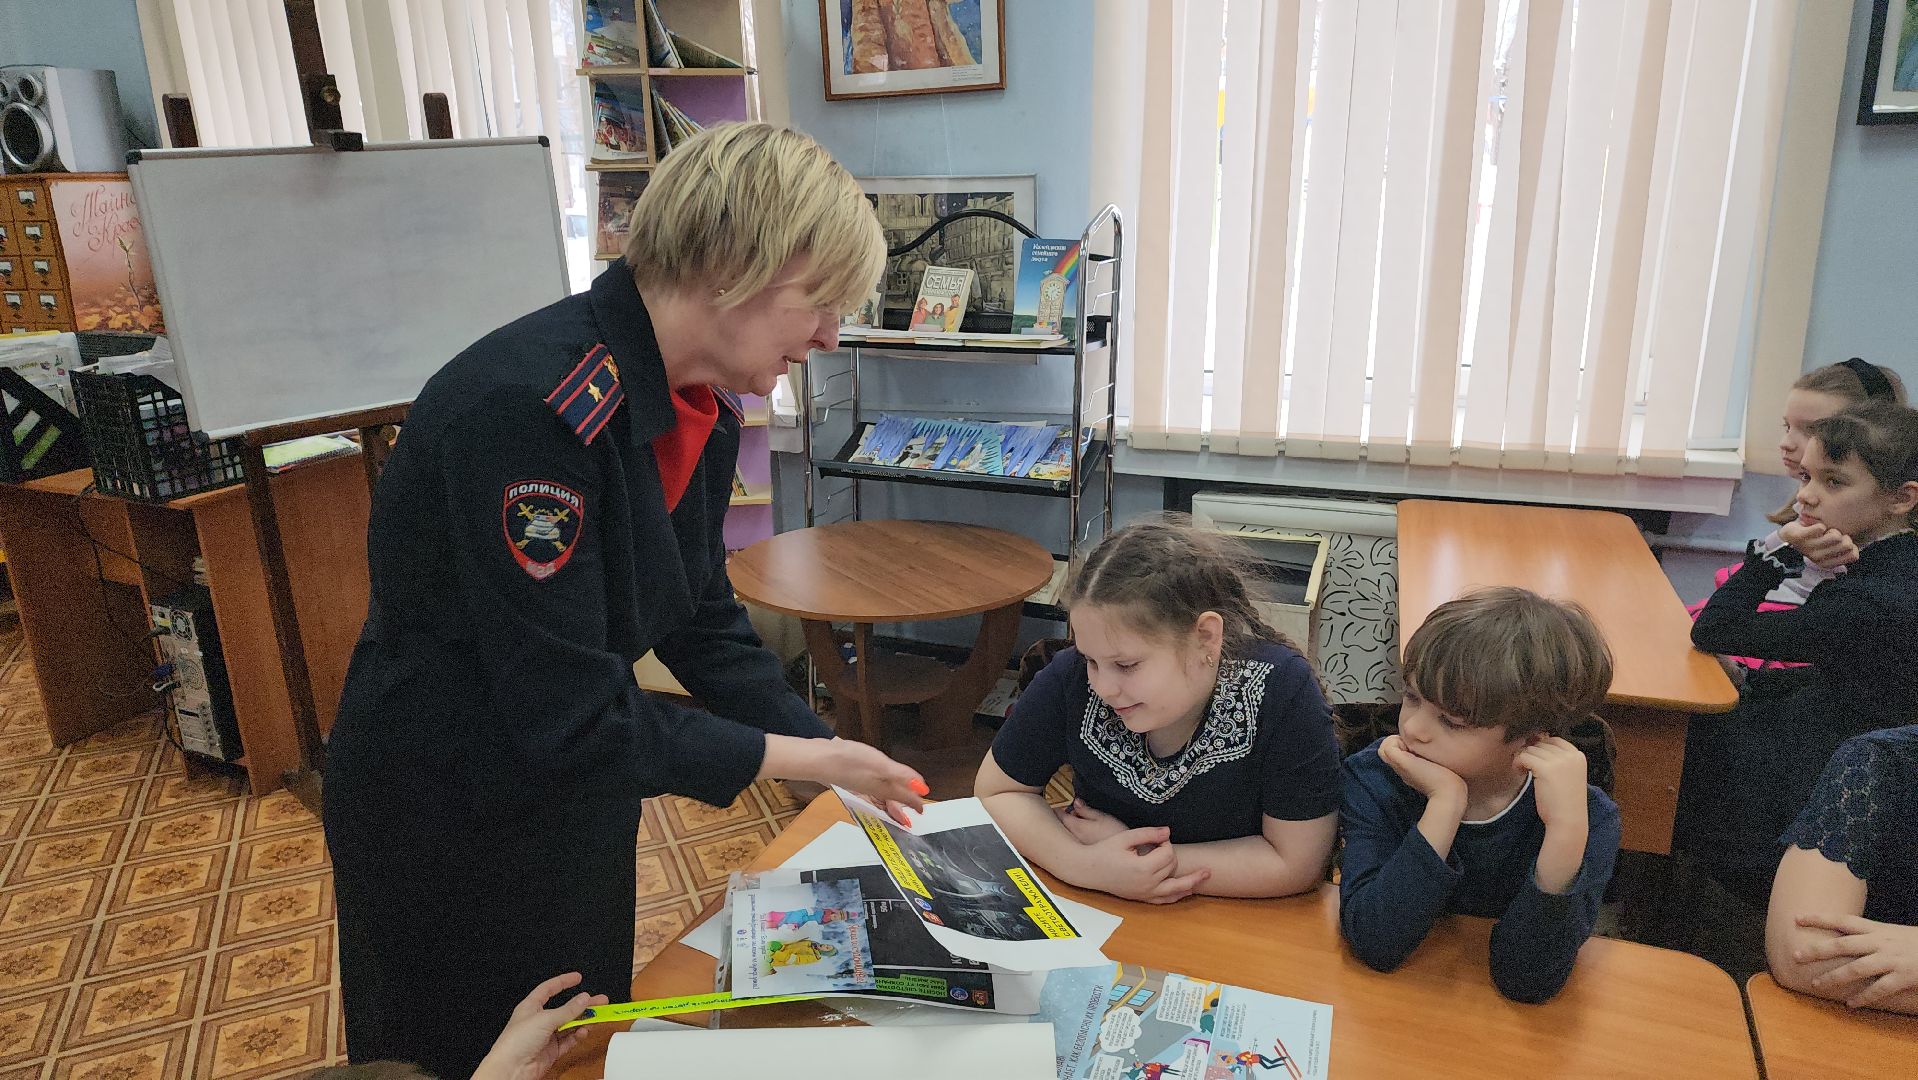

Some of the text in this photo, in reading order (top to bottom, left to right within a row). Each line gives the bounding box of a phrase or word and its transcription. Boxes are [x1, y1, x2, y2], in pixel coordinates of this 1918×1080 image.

[926, 275, 966, 290] СЕМЬЯ
[509, 484, 579, 507] ПОЛИЦИЯ
[1032, 912, 1060, 938] НОСИТЕ
